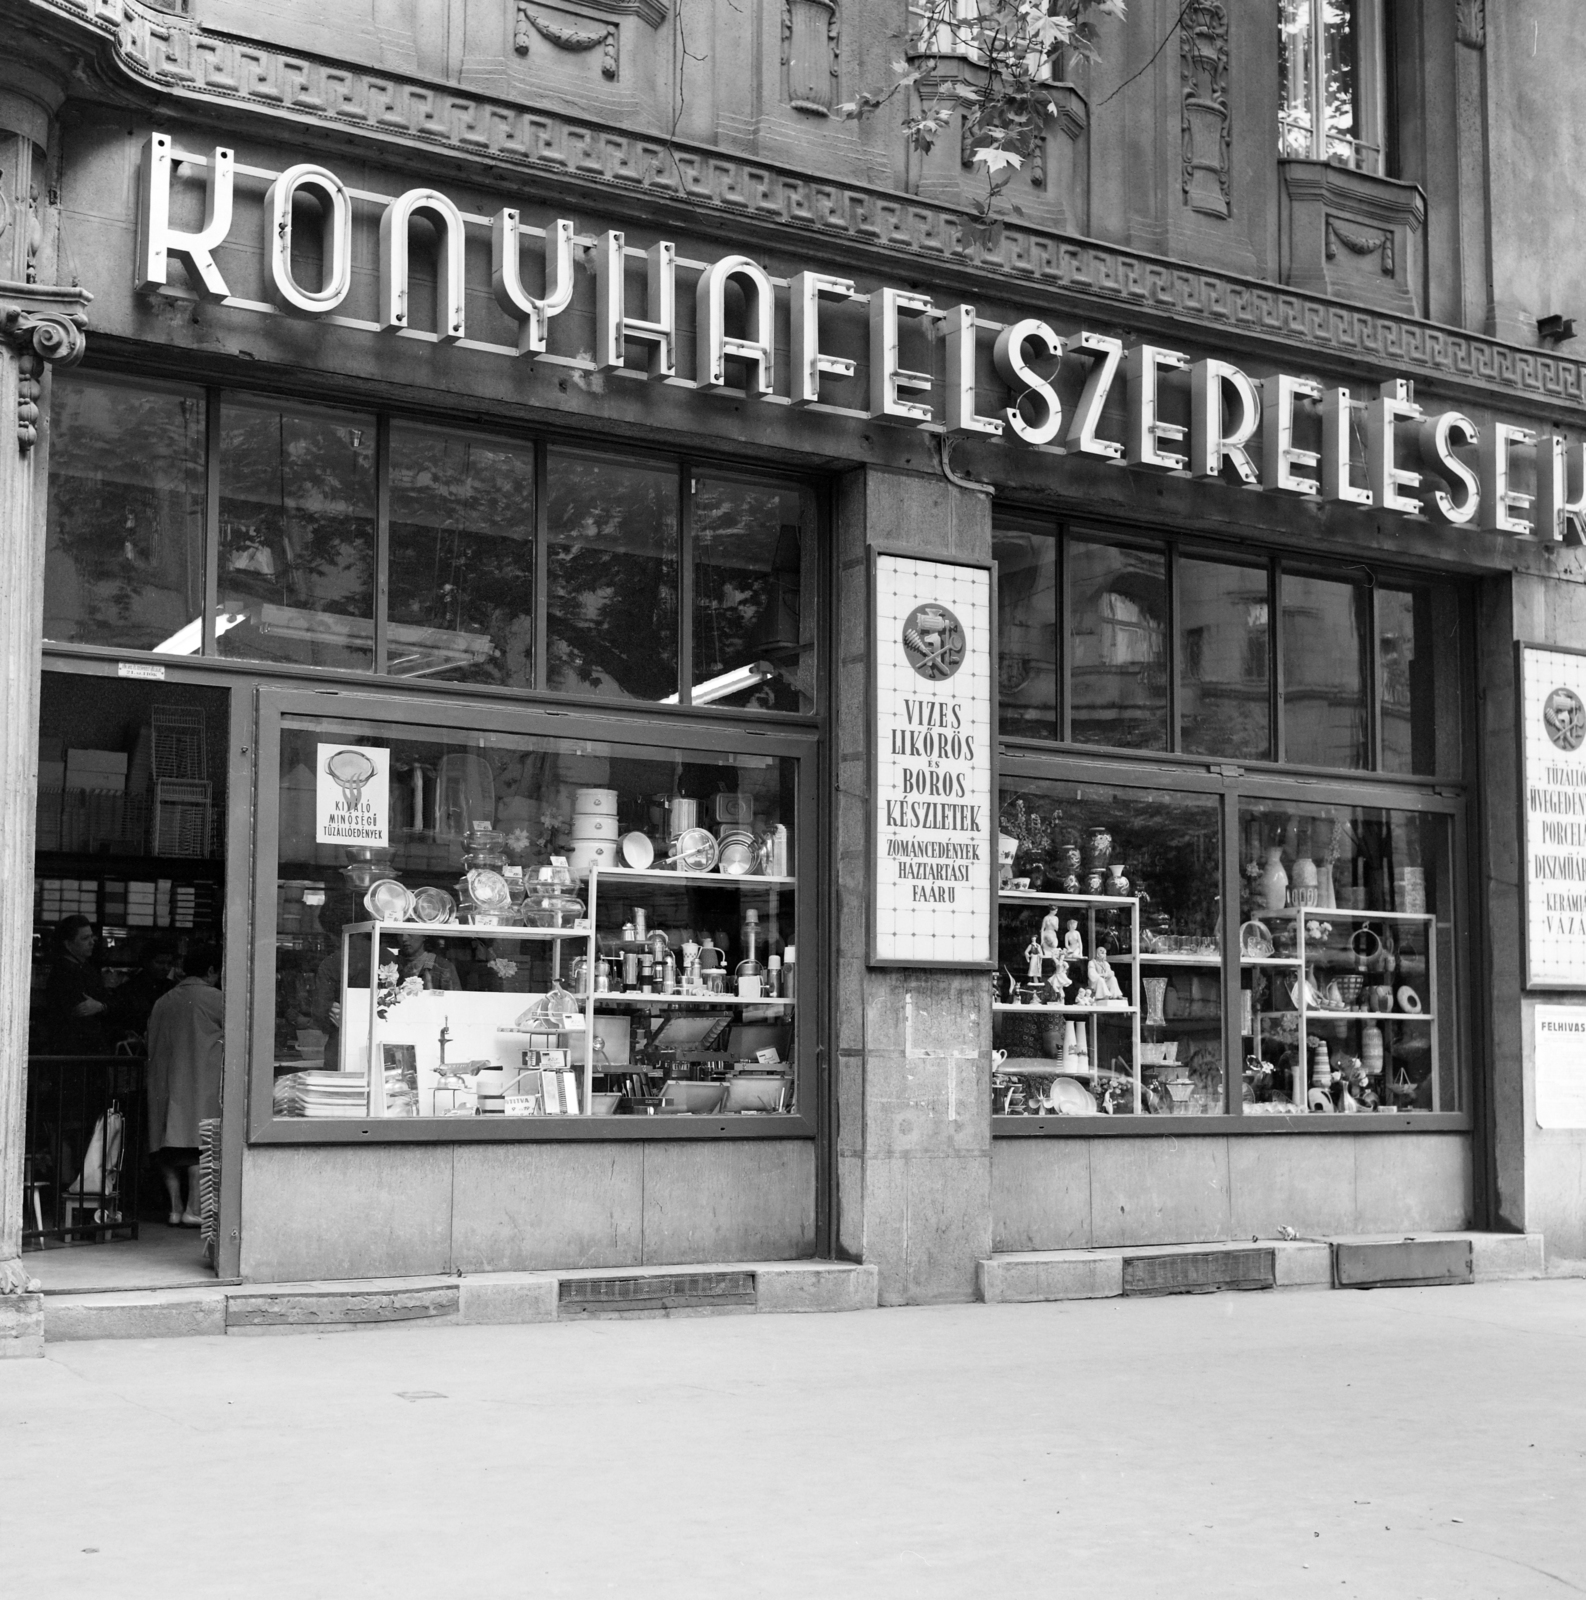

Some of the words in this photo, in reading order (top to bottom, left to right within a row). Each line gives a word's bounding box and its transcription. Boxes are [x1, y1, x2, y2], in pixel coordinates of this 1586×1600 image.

[139, 132, 1586, 544] KONYHAFELSZERELÉSEK
[904, 699, 961, 730] VIZES
[891, 727, 974, 761] LIKŐRÖS
[927, 757, 940, 769] ÉS
[902, 767, 965, 798] BOROS
[335, 798, 371, 813] KIVÁLÓ
[886, 795, 981, 832] KÉSZLETEK
[1530, 785, 1586, 816] ÜVEGEDÉN
[887, 835, 980, 860] ZOMÁNCEDÉNYEK
[898, 857, 969, 882] HÁZTARTÁSI
[912, 881, 955, 903] FAÁRU
